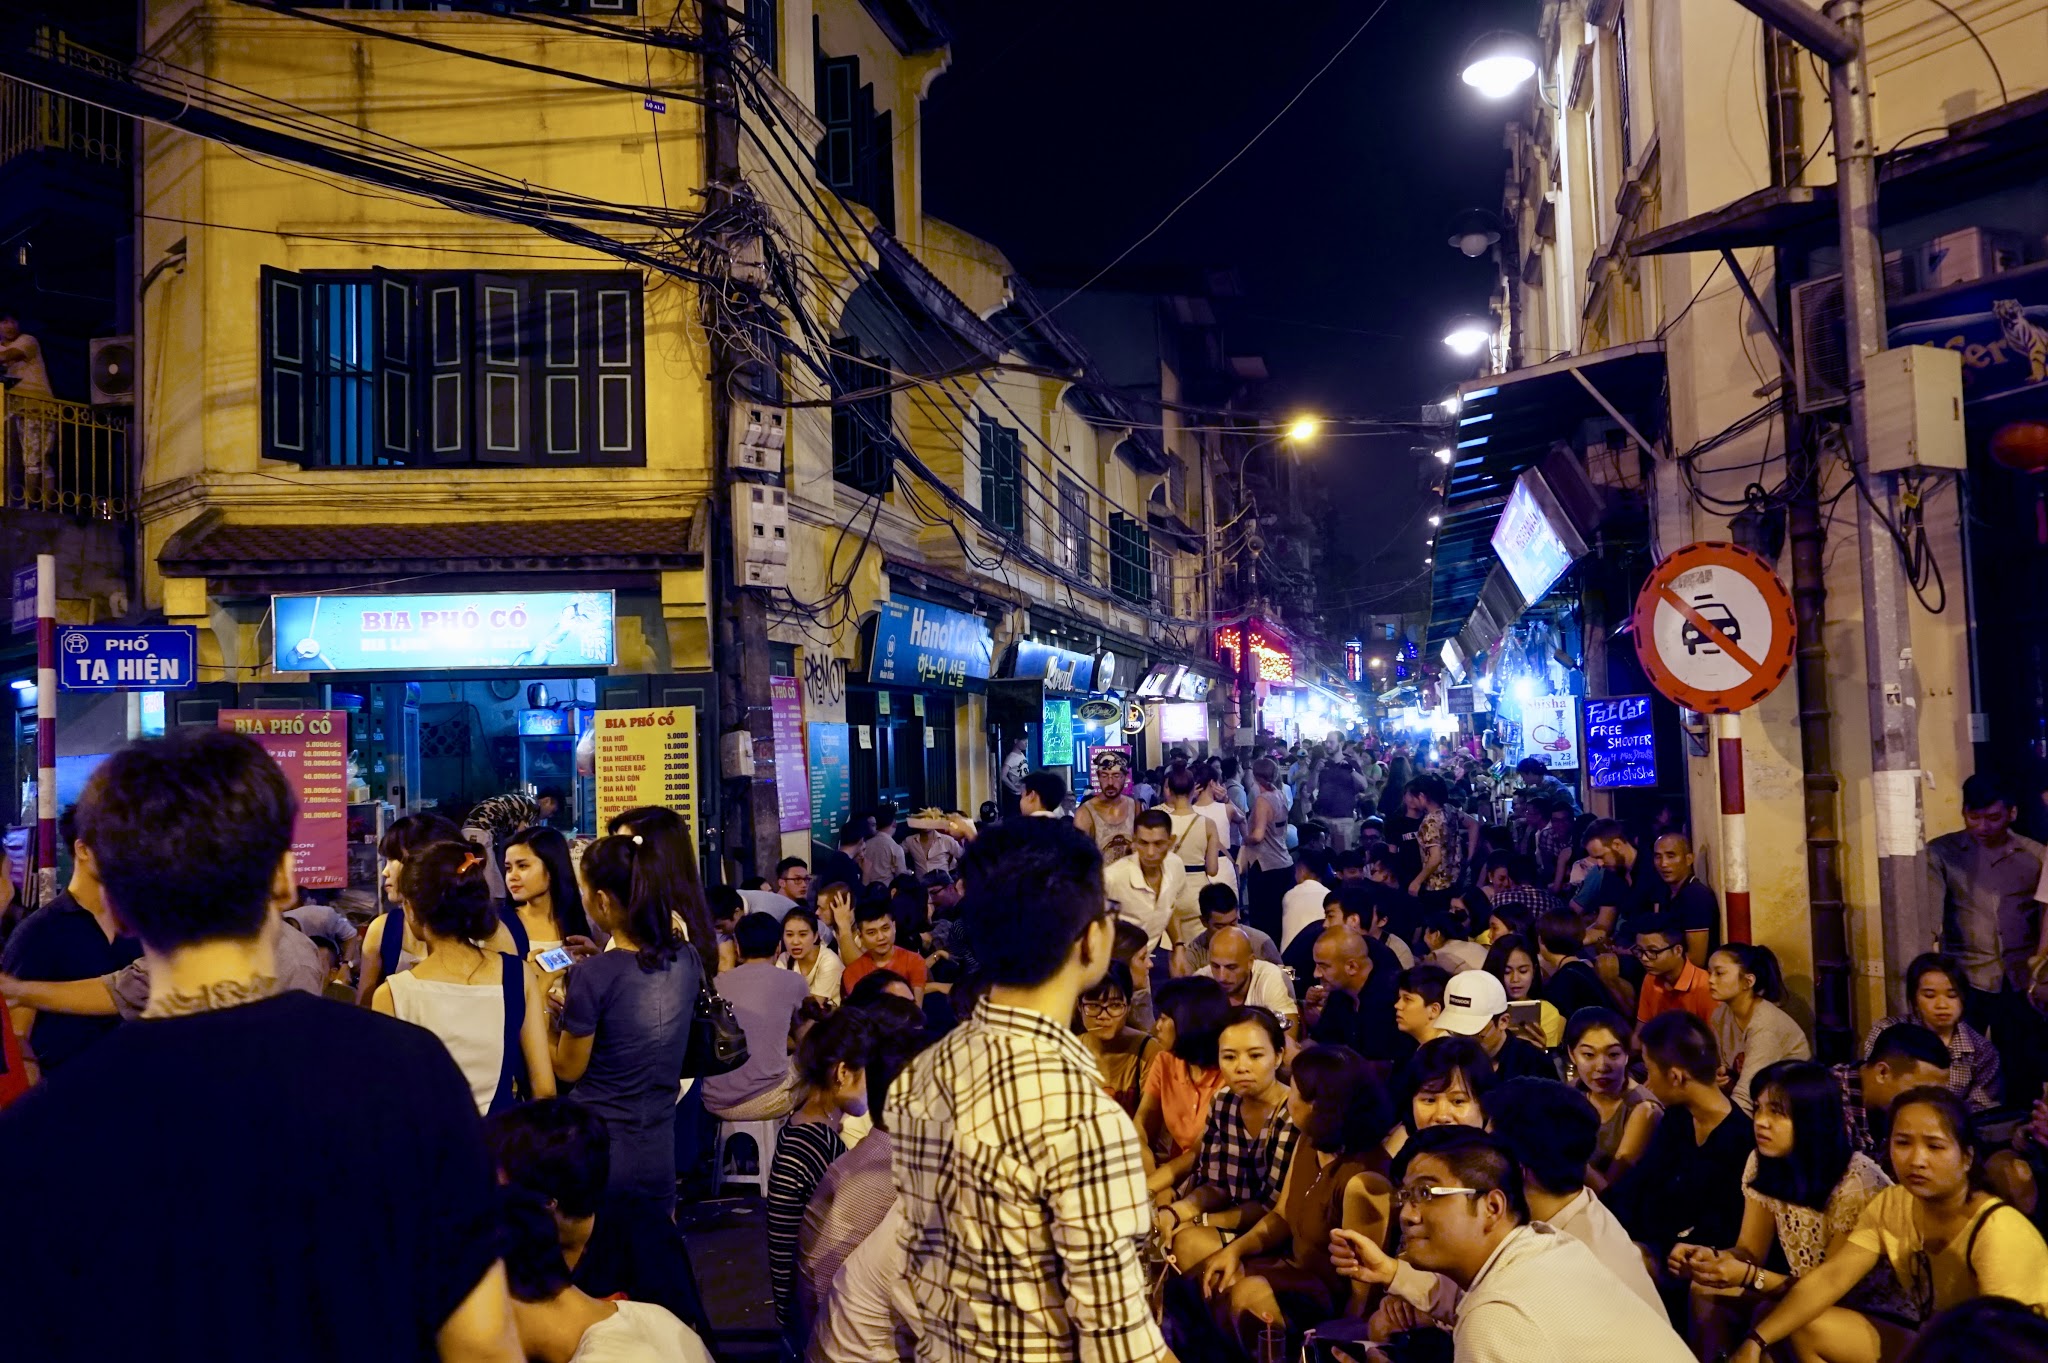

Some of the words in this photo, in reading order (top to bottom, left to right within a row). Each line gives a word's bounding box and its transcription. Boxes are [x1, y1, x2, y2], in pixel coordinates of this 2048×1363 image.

[362, 611, 412, 631] BIA
[420, 603, 480, 629] PHỐ
[489, 602, 528, 628] CỔ
[910, 607, 952, 652] Hanoi
[105, 633, 149, 651] PHỐ
[76, 658, 110, 684] TẠ
[118, 654, 178, 684] HIỆN
[918, 653, 948, 685] 하노이
[948, 660, 966, 688] 선물
[605, 718, 626, 728] BIA
[630, 712, 655, 728] PHỐ
[658, 710, 675, 726] CỔ
[1587, 702, 1618, 723] Fat
[1618, 699, 1646, 720] Cat
[234, 719, 266, 735] BIA
[270, 712, 304, 734] PHỐ
[308, 712, 332, 734] CỔ
[536, 716, 563, 731] Tiger
[1591, 725, 1622, 736] FREE
[1608, 734, 1652, 749] SHOOTER
[300, 876, 310, 884] 18
